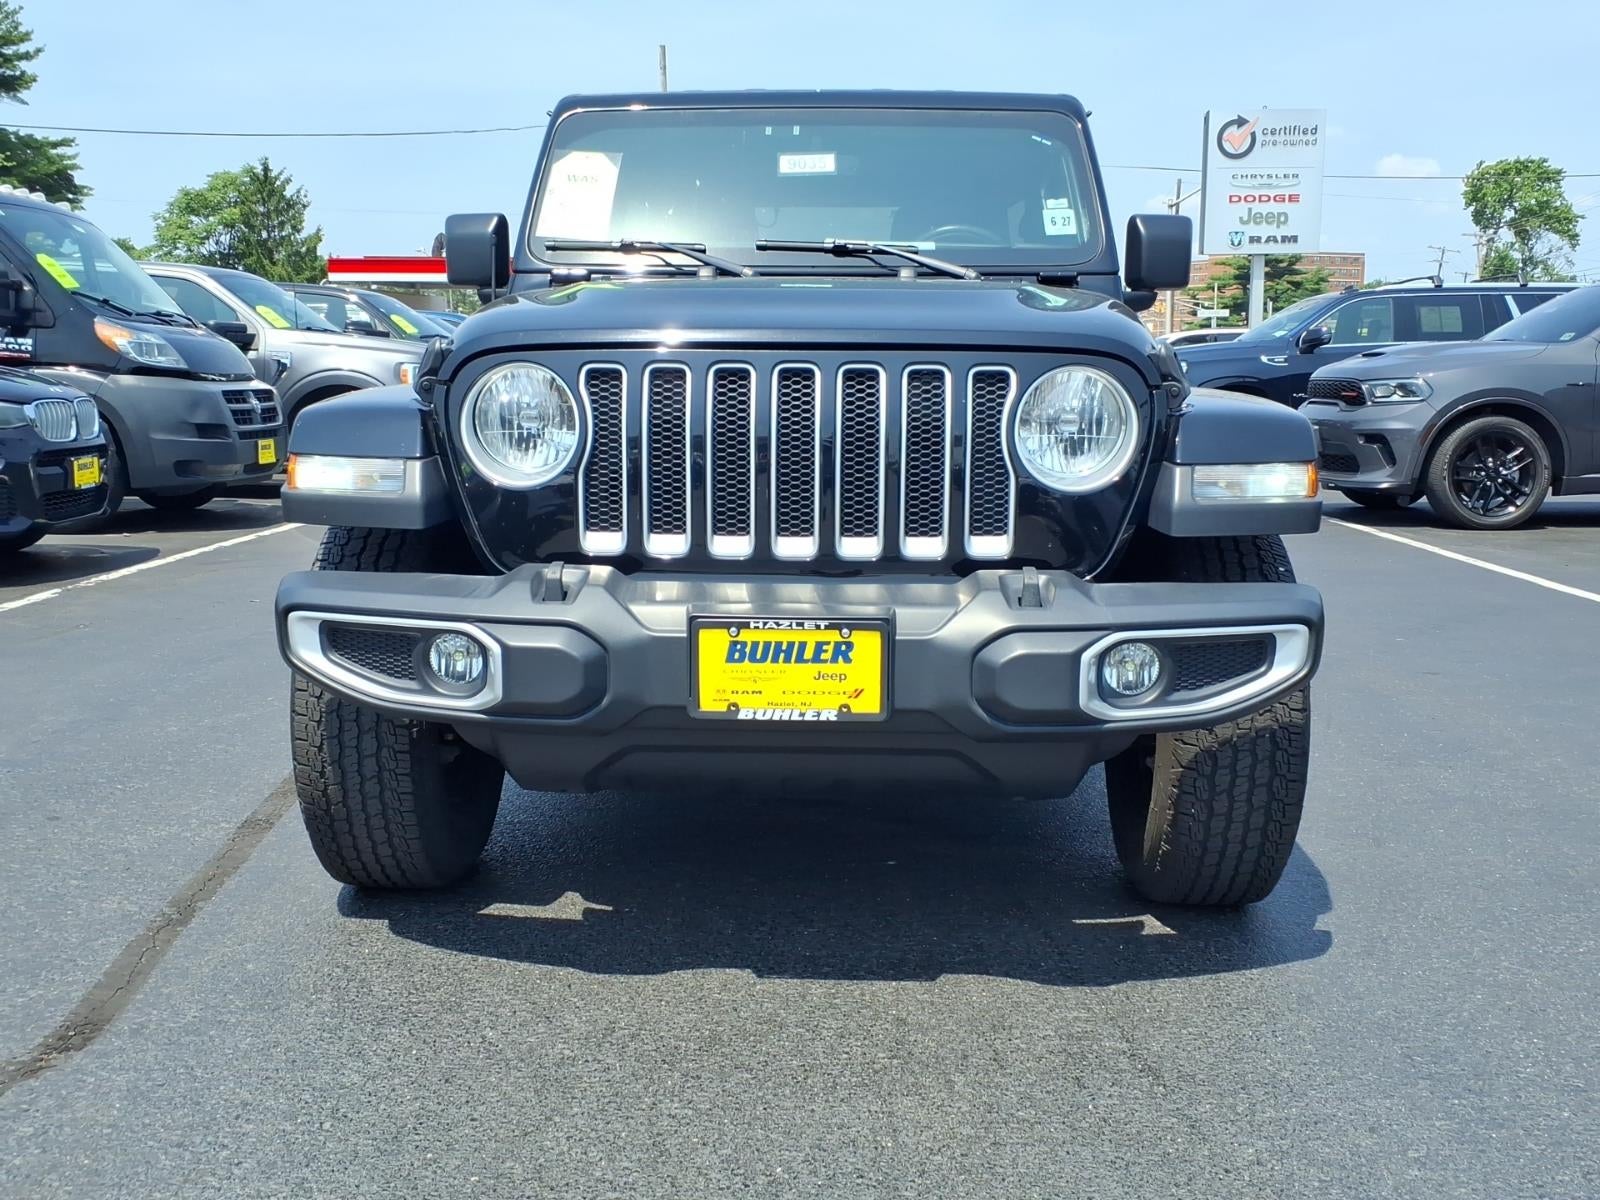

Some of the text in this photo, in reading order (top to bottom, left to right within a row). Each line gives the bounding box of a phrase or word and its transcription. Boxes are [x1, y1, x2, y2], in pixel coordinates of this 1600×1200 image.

[1261, 124, 1318, 136] certified
[1260, 137, 1318, 148] pre-owned
[1228, 193, 1301, 203] DODGE
[1050, 216, 1071, 226] 6 27
[1238, 207, 1289, 229] Jeep
[1248, 234, 1299, 244] RAM
[0, 336, 32, 345] AM
[749, 620, 830, 630] HAZLET
[725, 639, 855, 664] BUHLER
[813, 670, 848, 683] Jeep
[737, 707, 839, 721] BUHLER
